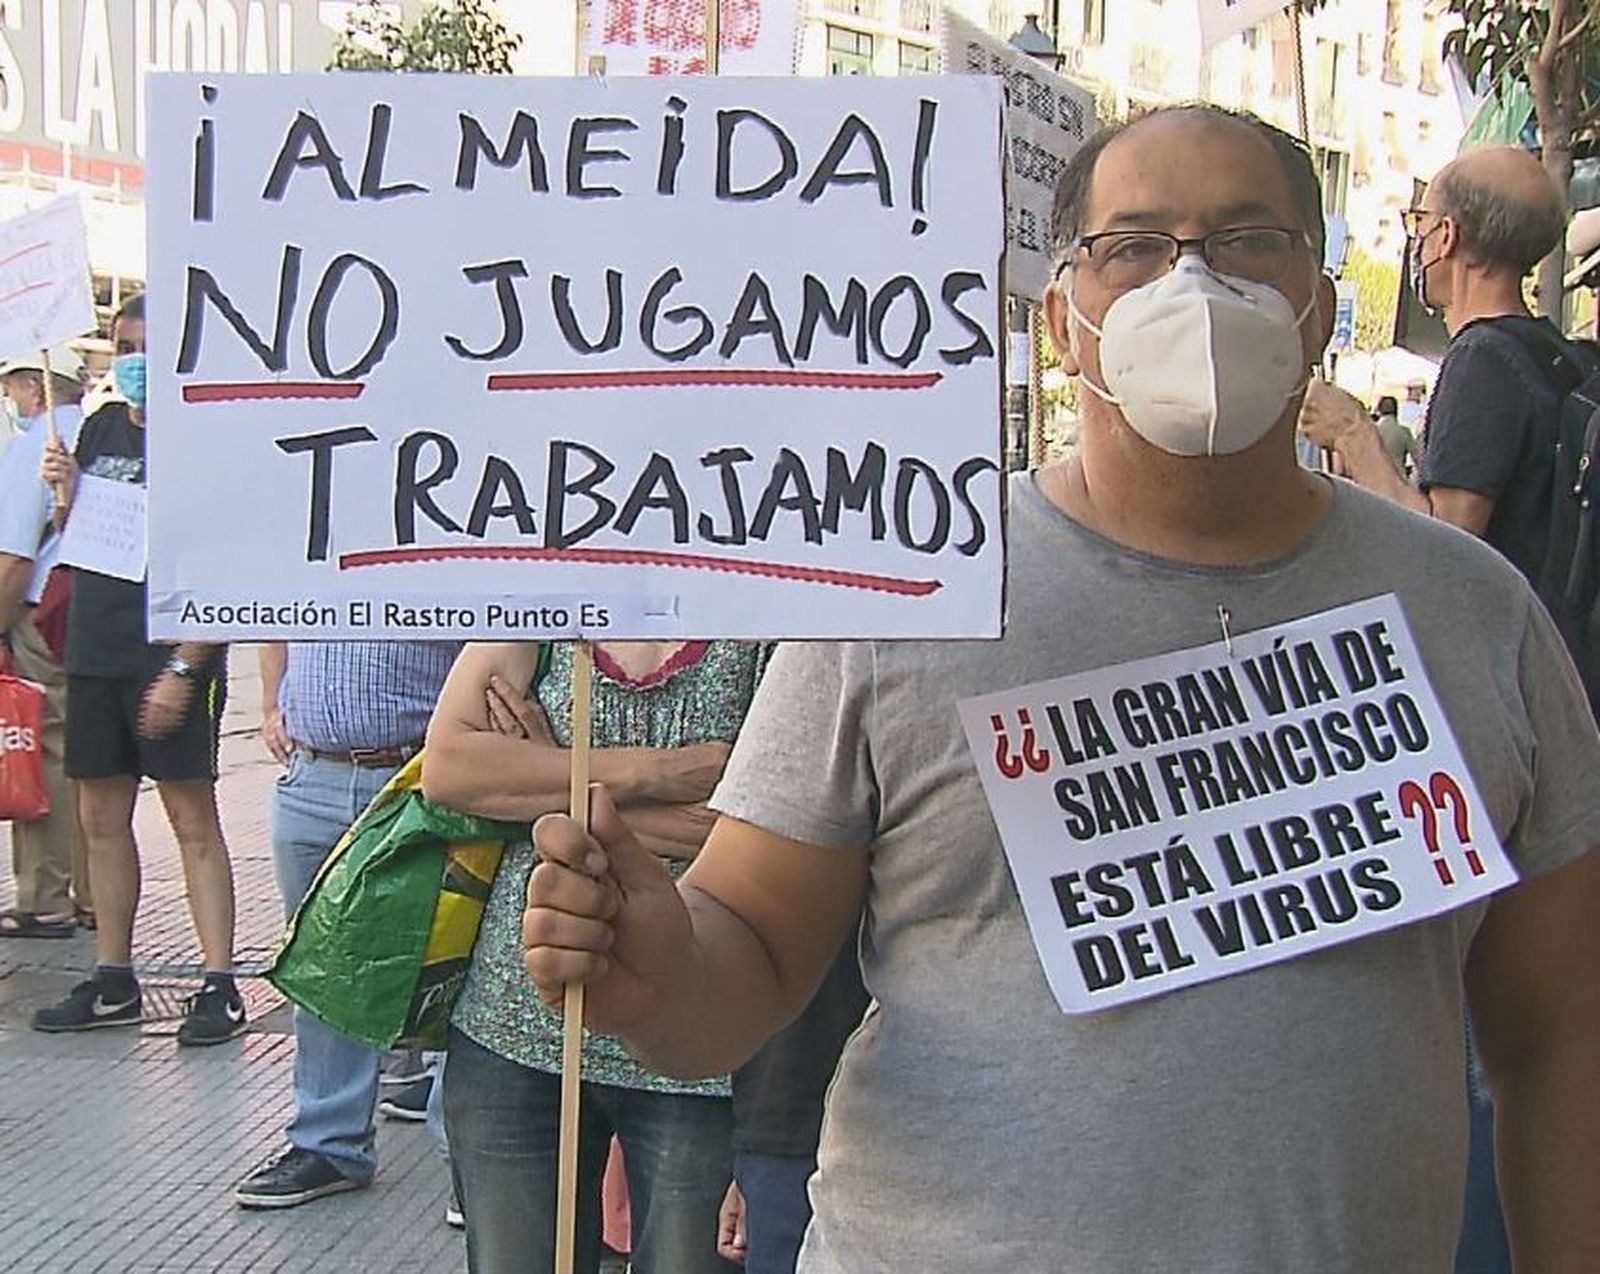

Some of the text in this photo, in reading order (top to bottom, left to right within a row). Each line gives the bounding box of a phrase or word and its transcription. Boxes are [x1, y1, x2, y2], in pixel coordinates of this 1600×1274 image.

[176, 245, 398, 380] NO
[445, 260, 995, 369] JUGAMOS
[275, 427, 999, 562] TRABAJAMOS
[180, 600, 610, 629] Asociación El Rastro Punto Es
[1113, 666, 1249, 748] GRAN
[1242, 637, 1340, 715] VÍA
[1332, 621, 1405, 693] DE
[1055, 693, 1429, 841] SAN FRANCISCO
[1051, 834, 1214, 928] ESTÁ
[1074, 918, 1195, 992] DEL
